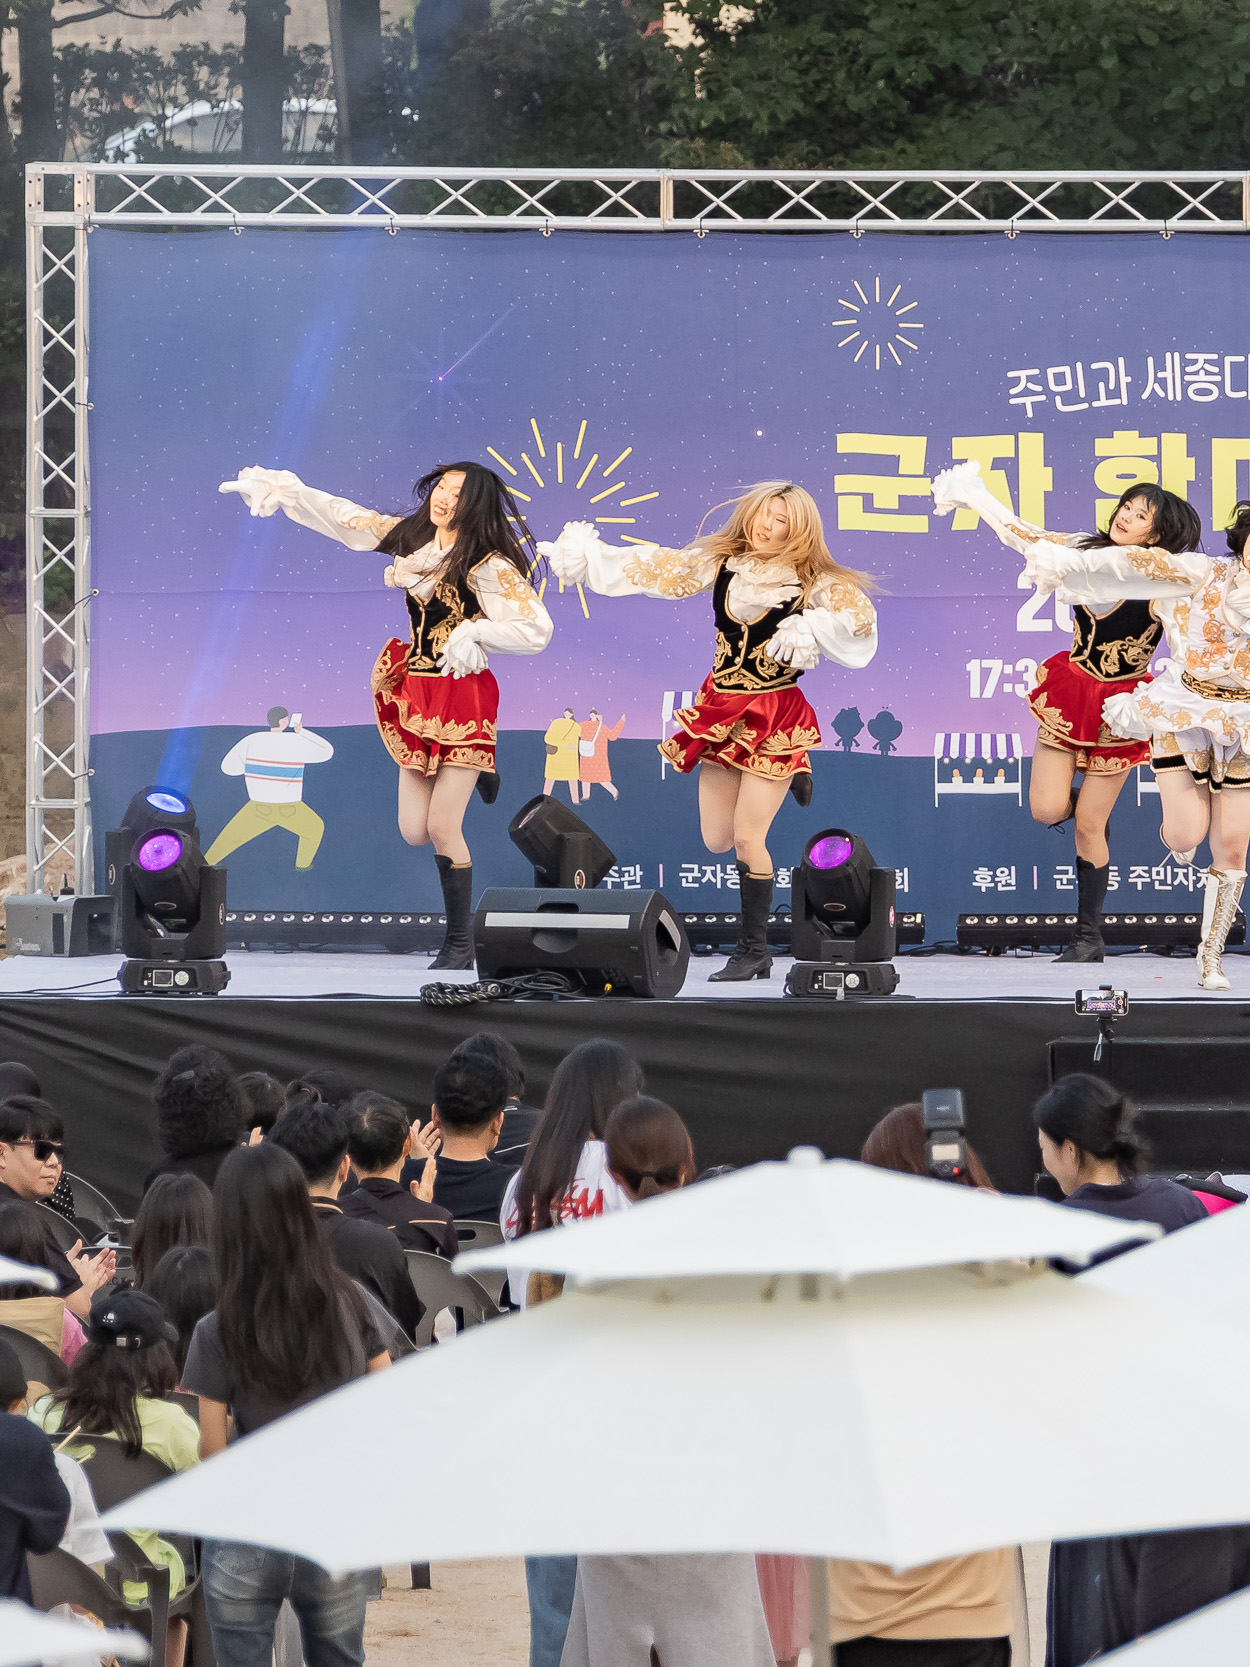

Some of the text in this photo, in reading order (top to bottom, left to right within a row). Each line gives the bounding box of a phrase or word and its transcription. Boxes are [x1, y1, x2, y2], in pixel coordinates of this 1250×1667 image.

[1006, 356, 1132, 418] 주민과
[834, 431, 1053, 534] 군자
[965, 657, 1046, 699] 17:3
[972, 865, 1017, 892] 후원
[1053, 864, 1121, 891] 군동
